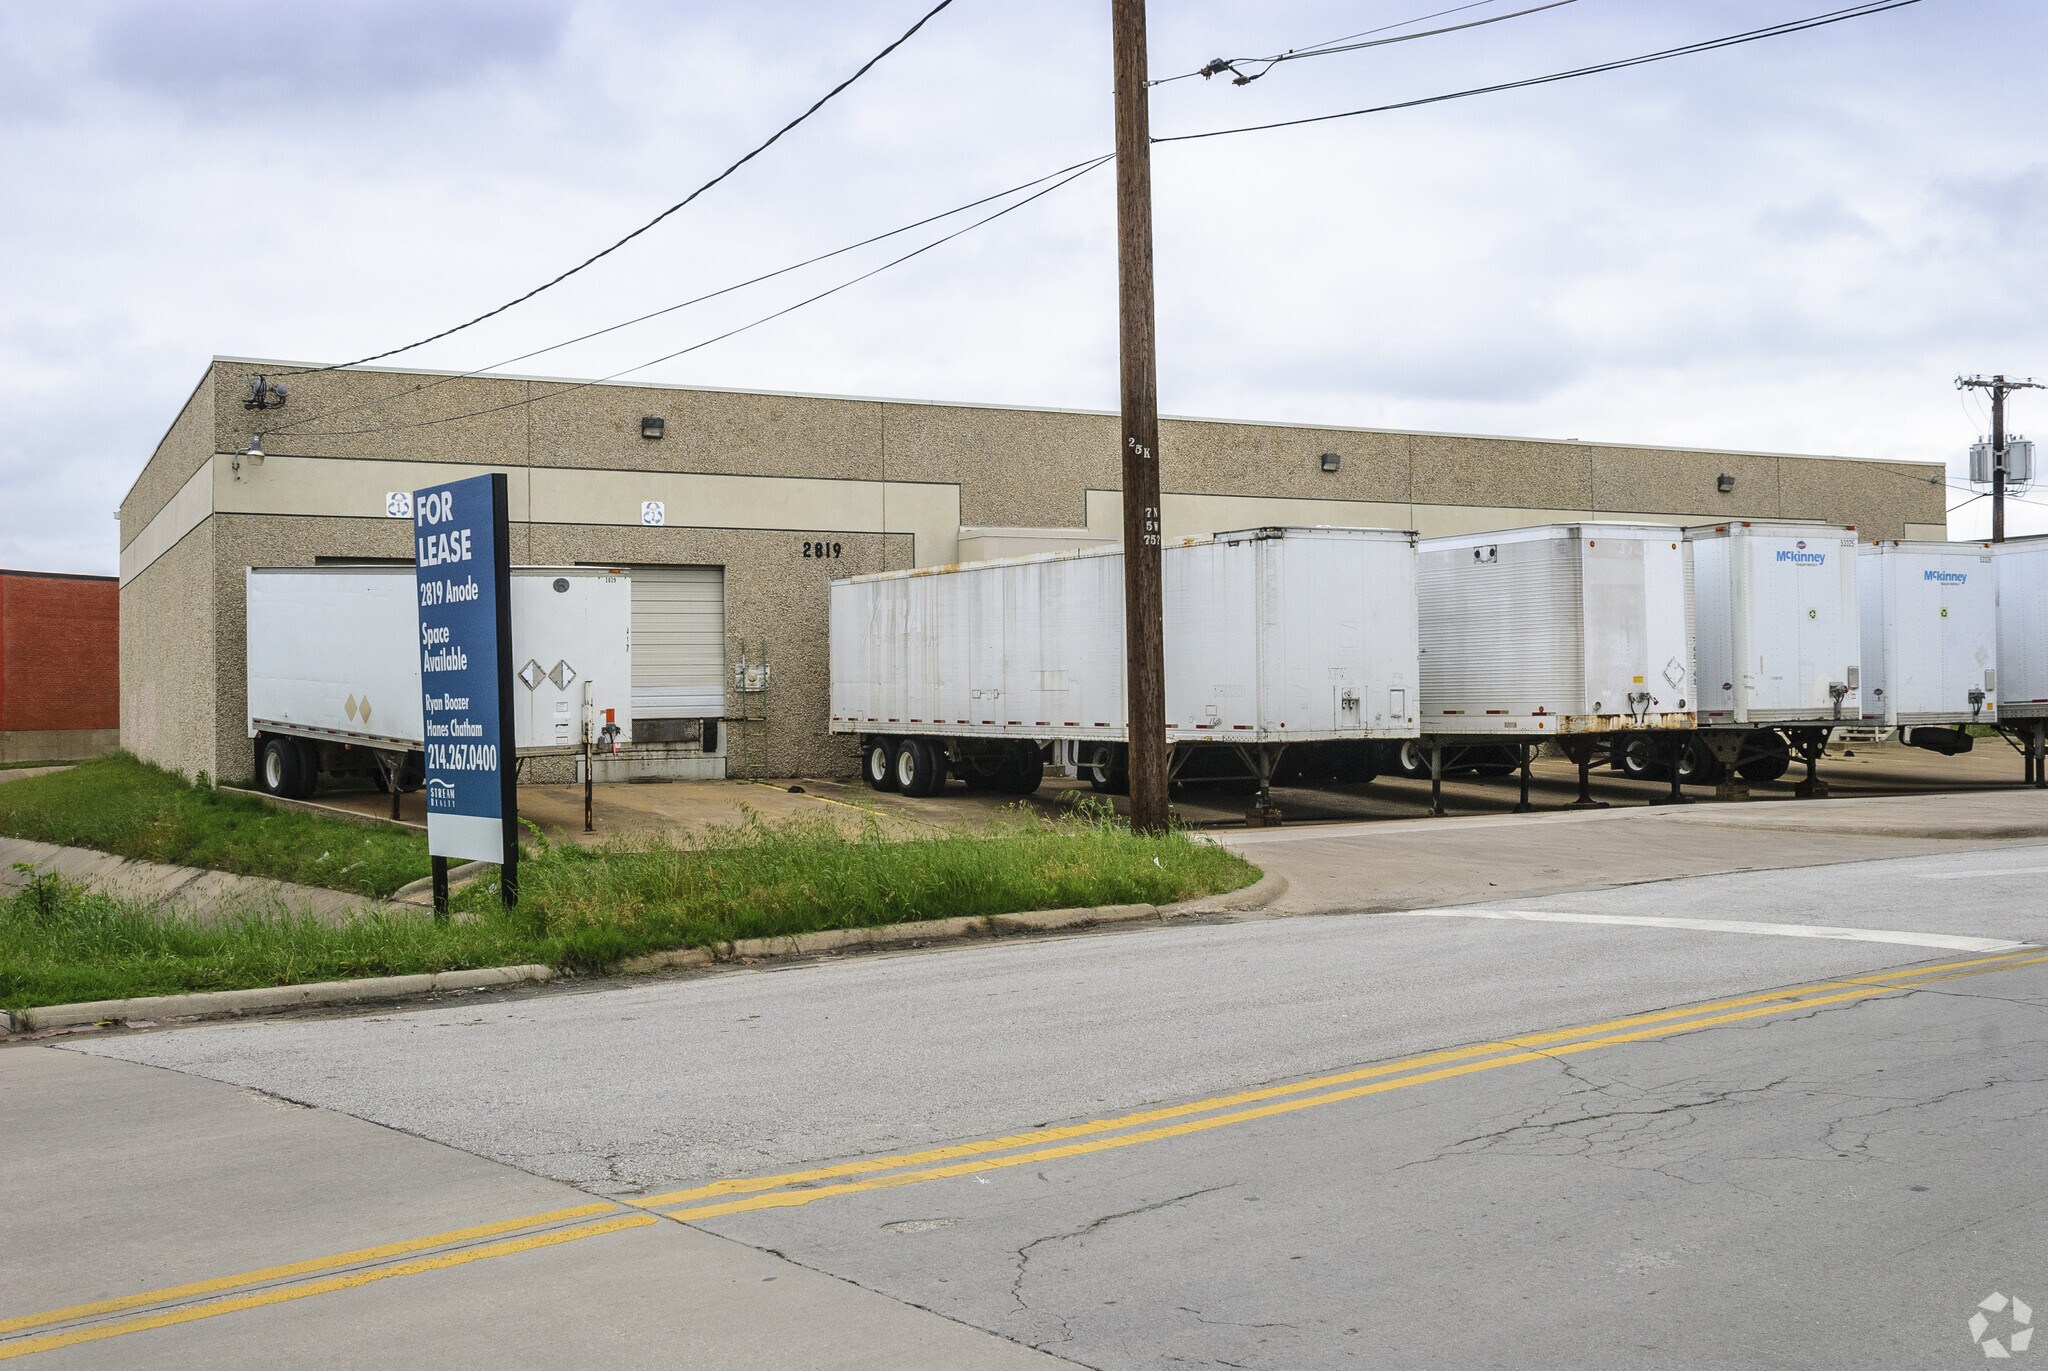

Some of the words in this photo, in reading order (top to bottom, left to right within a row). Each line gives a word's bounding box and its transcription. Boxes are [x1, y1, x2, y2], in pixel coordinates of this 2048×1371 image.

[1128, 437, 1151, 459] 25K
[396, 502, 402, 513] 1
[417, 491, 453, 527] FOR
[418, 529, 472, 567] LEASE
[803, 541, 842, 559] 2819
[420, 580, 443, 607] 2819
[446, 575, 479, 604] Anode
[422, 622, 450, 650] Space
[423, 646, 468, 673] Available
[425, 693, 443, 715] Ryan
[444, 692, 470, 711] Boozer
[426, 719, 450, 737] Hanes
[450, 718, 483, 737] Chatham
[428, 743, 497, 771] 214.267.0400
[430, 787, 455, 799] STREAM
[430, 798, 455, 808] REALTY
